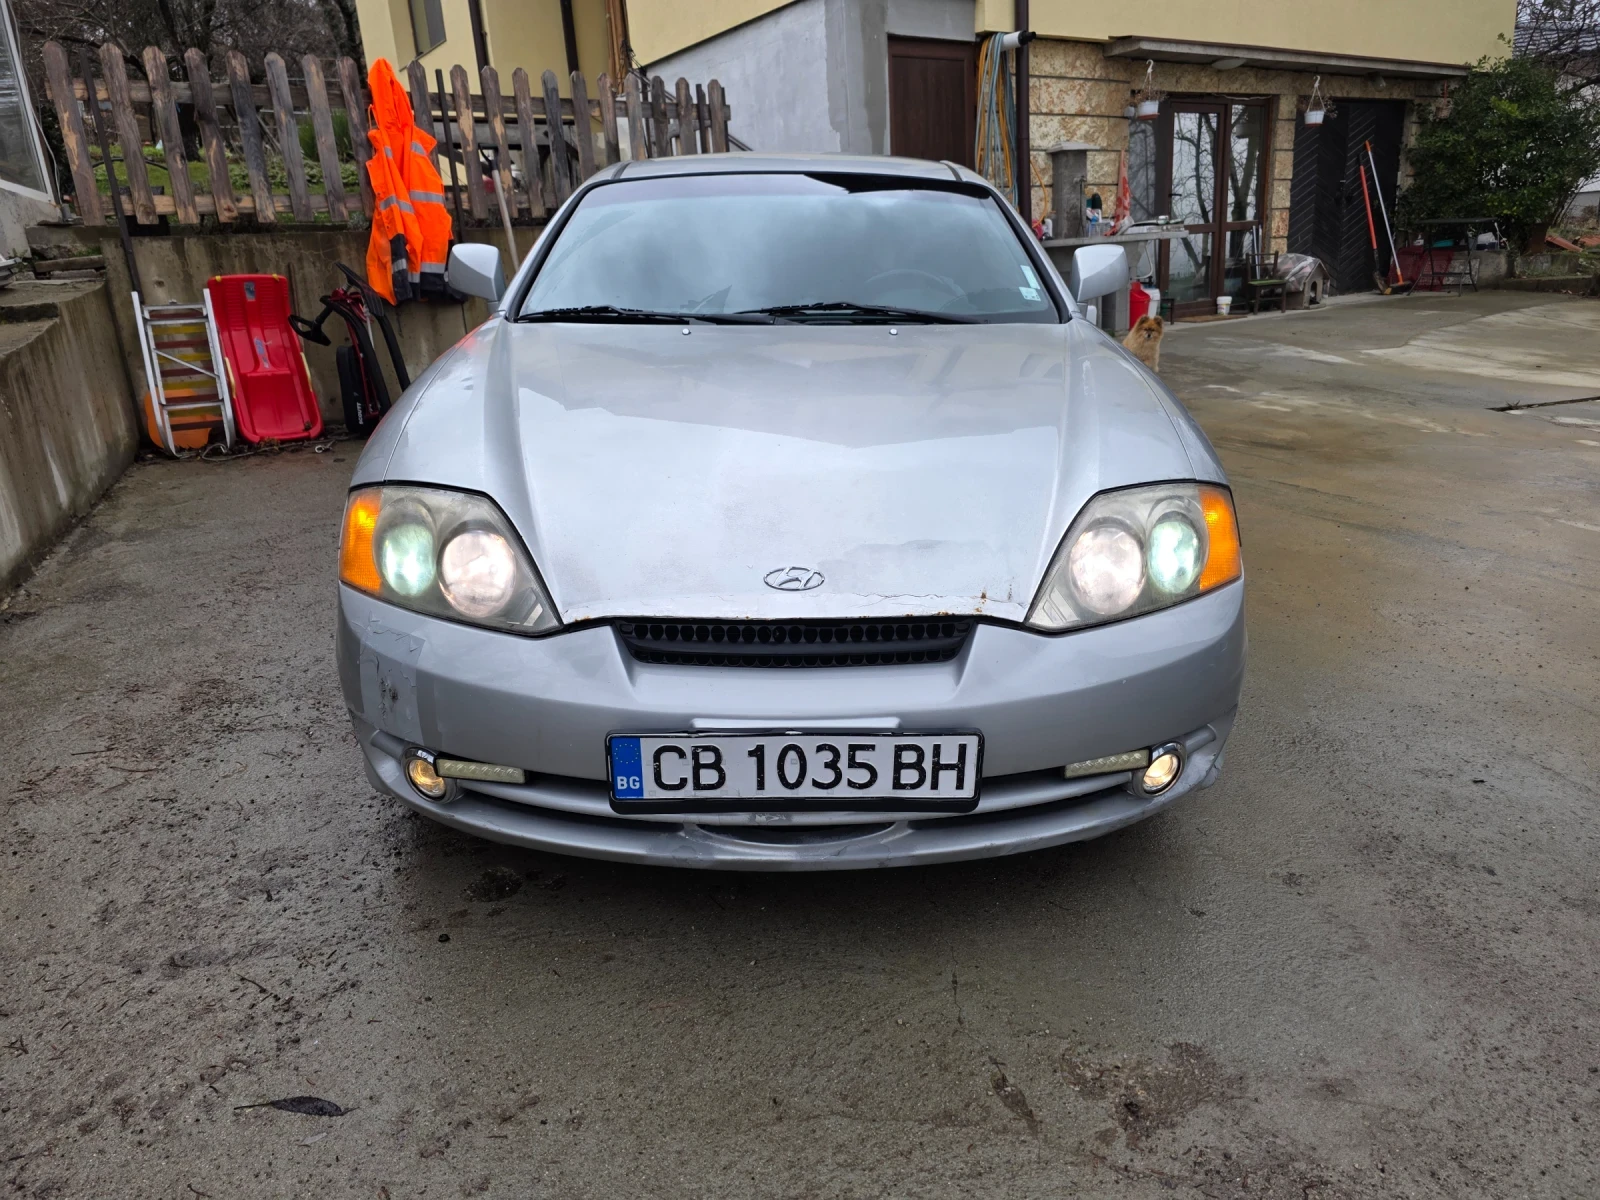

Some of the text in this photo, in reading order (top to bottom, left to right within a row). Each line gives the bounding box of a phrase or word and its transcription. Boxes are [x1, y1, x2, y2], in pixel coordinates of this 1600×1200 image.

[616, 775, 641, 790] BG
[653, 743, 965, 791] CB 1035 BH
